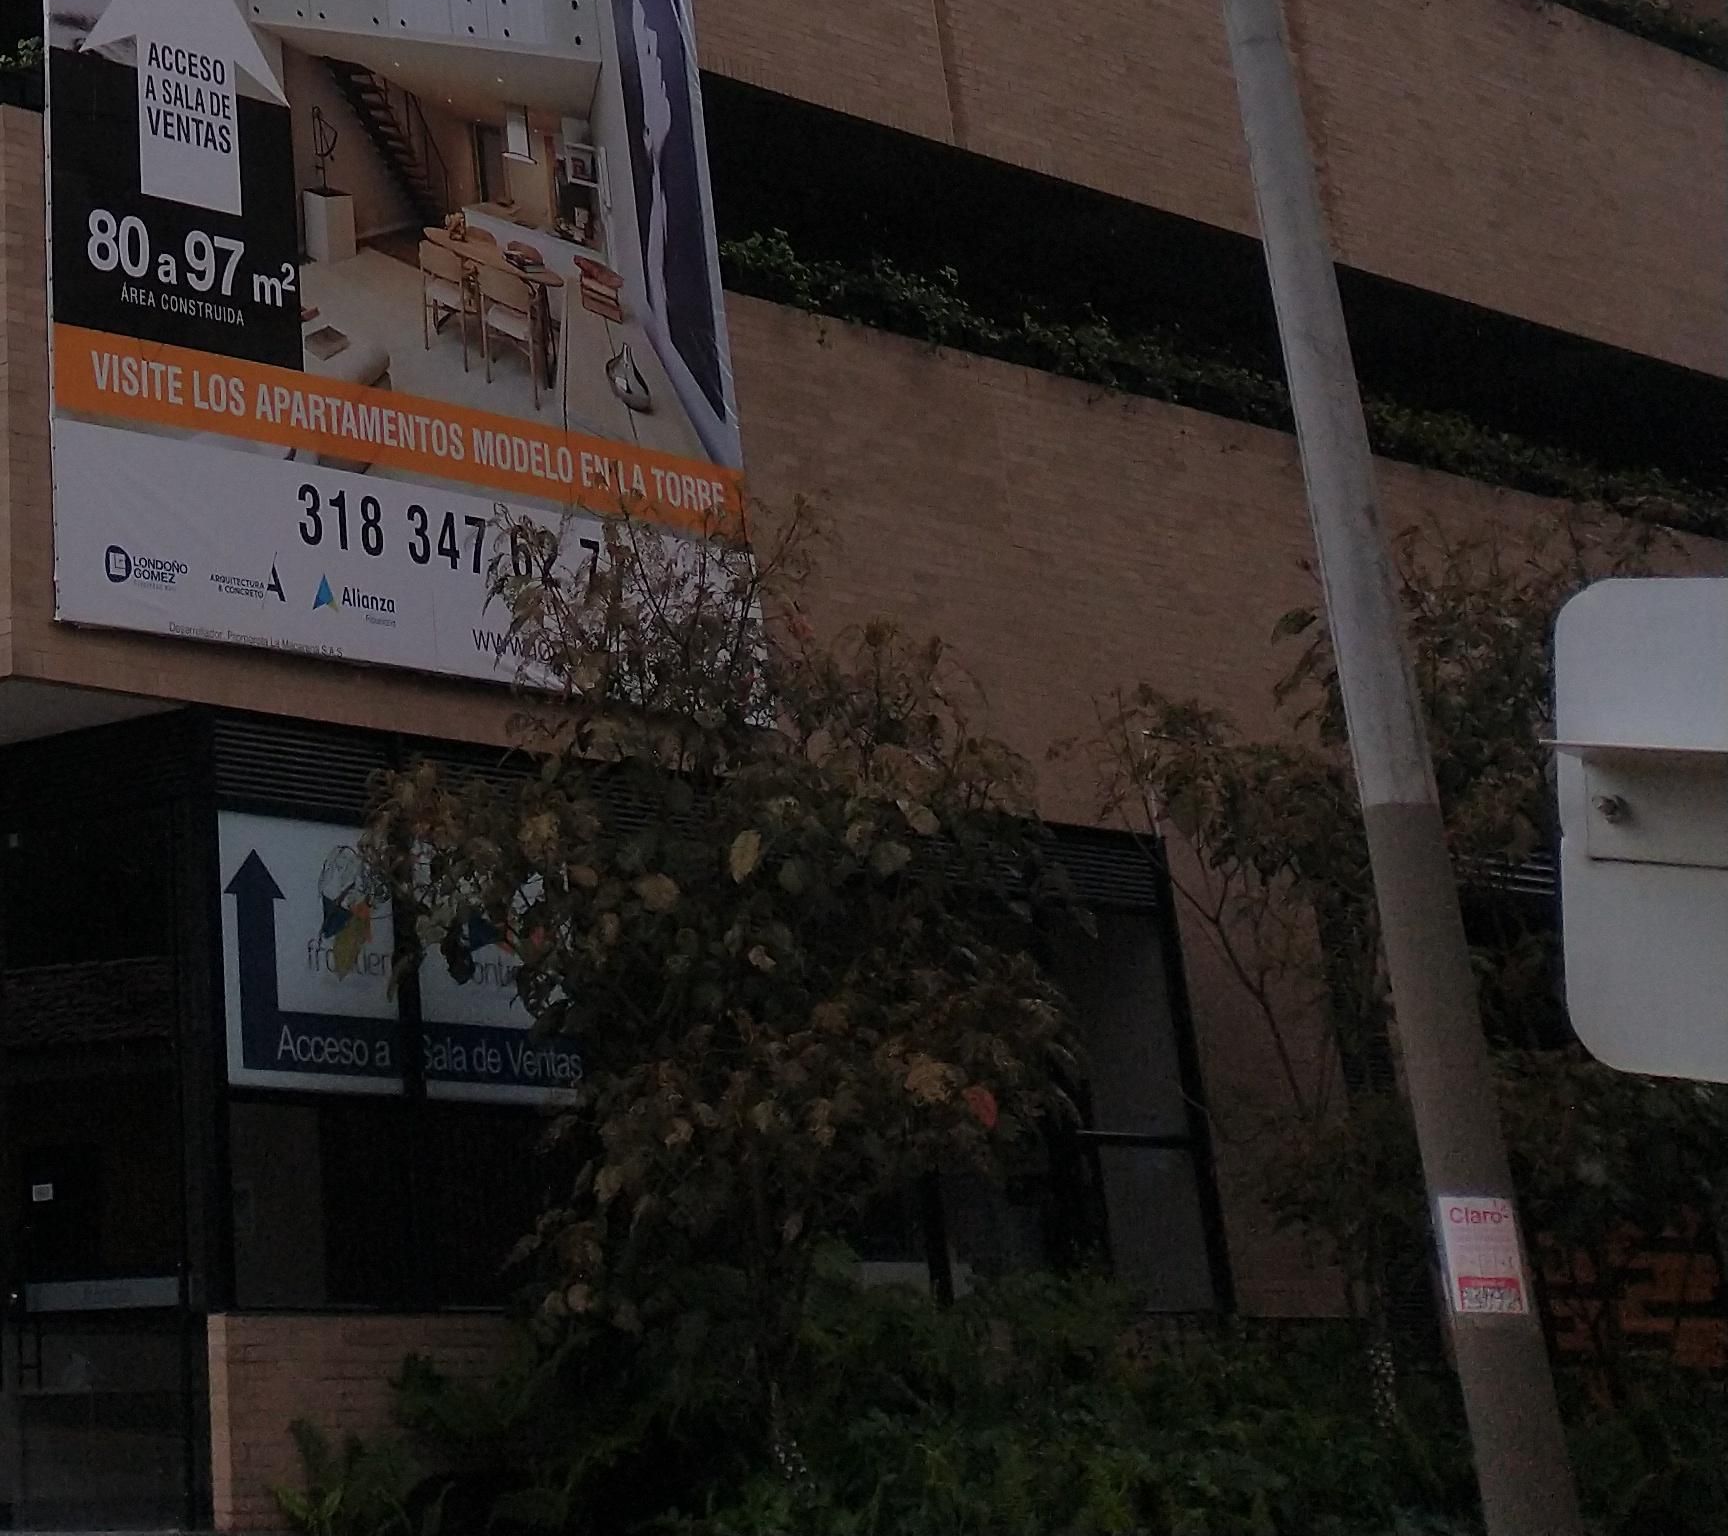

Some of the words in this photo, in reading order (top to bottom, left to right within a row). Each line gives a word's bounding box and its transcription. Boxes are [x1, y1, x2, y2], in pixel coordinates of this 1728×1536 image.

[148, 42, 226, 85] ACCESO
[145, 75, 157, 102] A
[162, 78, 205, 115] SALA
[209, 91, 232, 121] DE
[147, 106, 232, 154] VENTAS
[87, 208, 150, 278] 80
[157, 251, 178, 285] a
[184, 230, 245, 296] 97
[120, 282, 157, 308] ÁREA
[161, 293, 246, 327] CONSTRUIDA
[91, 350, 184, 406] VISITE
[193, 370, 246, 416] LOS
[255, 383, 465, 462] APARTAMENTOS
[472, 427, 573, 483] MODELO
[580, 451, 610, 491] EN
[617, 459, 648, 501] LA
[651, 467, 725, 513] TORRE
[298, 483, 384, 556] 318
[407, 504, 486, 574] 347
[133, 556, 188, 575] LONDOÑO
[133, 567, 176, 584] GOMEZ
[210, 573, 265, 590] ARQUITECTURA
[224, 586, 264, 599] CONCRETO
[342, 586, 396, 614] Alianza
[277, 1024, 368, 1067] Acceso
[375, 1040, 390, 1067] a
[423, 1034, 467, 1072] Sala
[473, 1038, 501, 1074] de
[508, 1040, 583, 1081] Ventas
[1449, 1206, 1503, 1225] Claro
